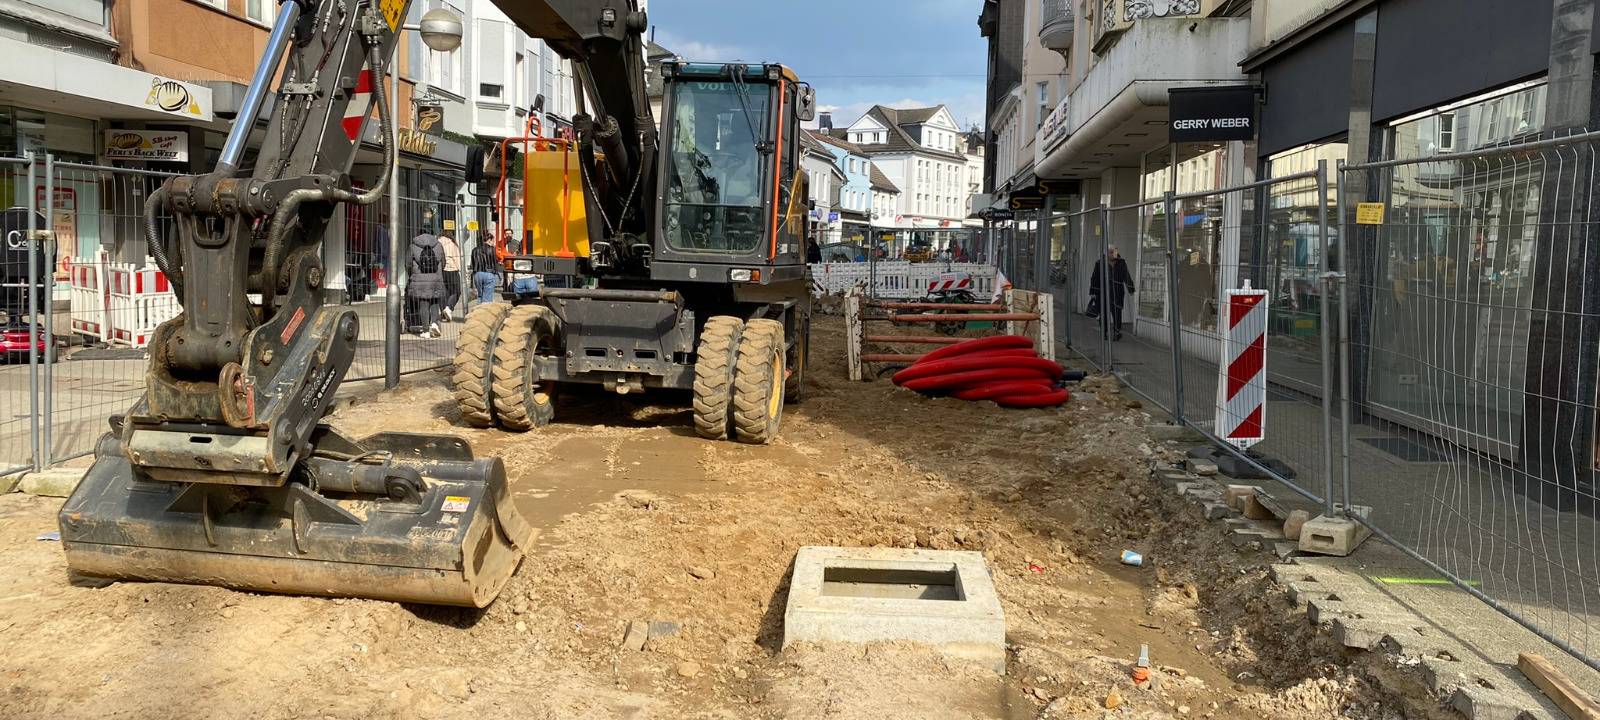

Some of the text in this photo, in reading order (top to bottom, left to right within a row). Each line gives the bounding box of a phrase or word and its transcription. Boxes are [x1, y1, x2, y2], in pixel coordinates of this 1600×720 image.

[697, 82, 751, 91] VOL
[1173, 117, 1250, 130] GERRY WEBER
